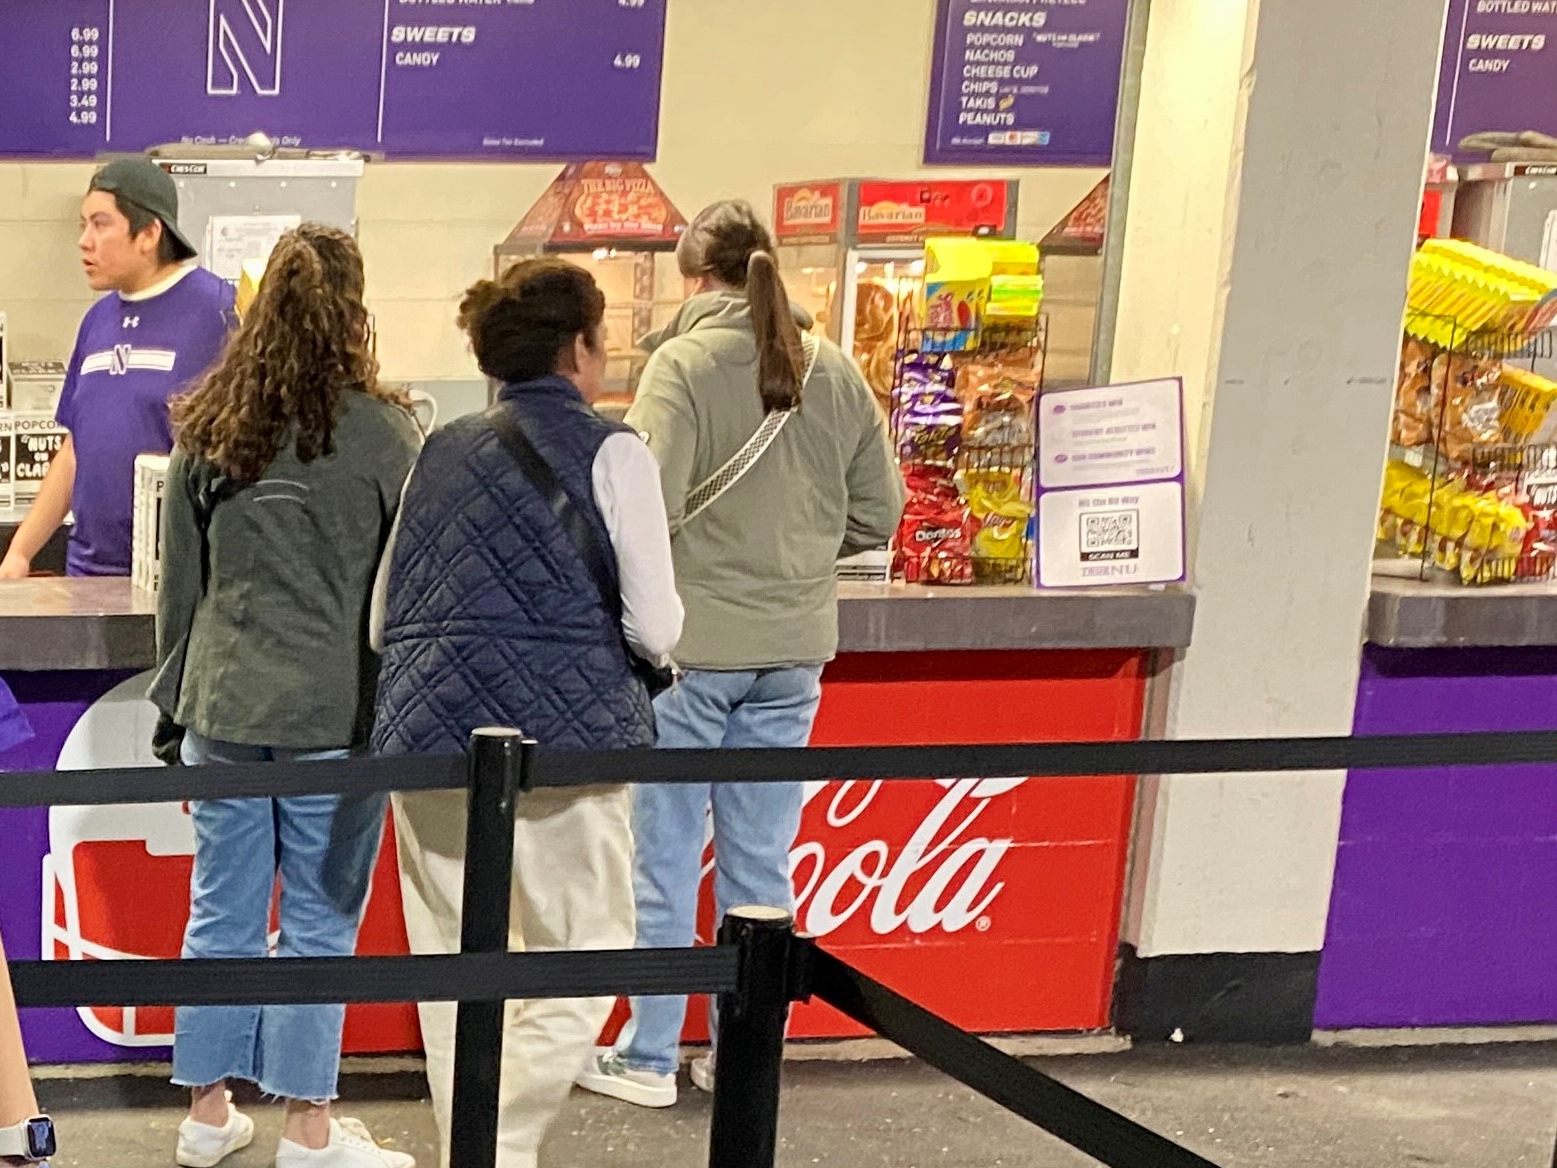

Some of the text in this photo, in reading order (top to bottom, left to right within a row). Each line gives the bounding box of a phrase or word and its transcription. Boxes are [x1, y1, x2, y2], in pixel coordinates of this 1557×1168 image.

[963, 11, 1047, 27] SNACKS
[71, 28, 99, 41] 6.99
[391, 27, 476, 43] SWEETS
[966, 33, 1024, 46] POPCORN
[1466, 34, 1546, 50] SWEETS
[70, 44, 99, 57] 6.99
[965, 50, 1015, 62] NACHOS
[395, 52, 641, 68] CANDY 4.99
[1468, 58, 1511, 72] CANDY
[70, 61, 99, 74] 2.99
[963, 65, 1039, 79] CHEESE CUP
[70, 77, 98, 91] 2.99
[961, 81, 998, 94] CHIPS
[70, 95, 97, 108] 3.49
[961, 96, 996, 109] TAKIS
[69, 111, 97, 124] 4.99
[958, 112, 1014, 126] PEANUTS
[195, 136, 216, 145] Cash
[282, 136, 302, 147] Only
[581, 178, 604, 193] THE
[785, 198, 831, 221] Bavarian
[861, 206, 924, 222] Bavarian
[14, 420, 56, 429] POPCO
[16, 461, 50, 478] CLAR
[915, 528, 962, 541] Doritos
